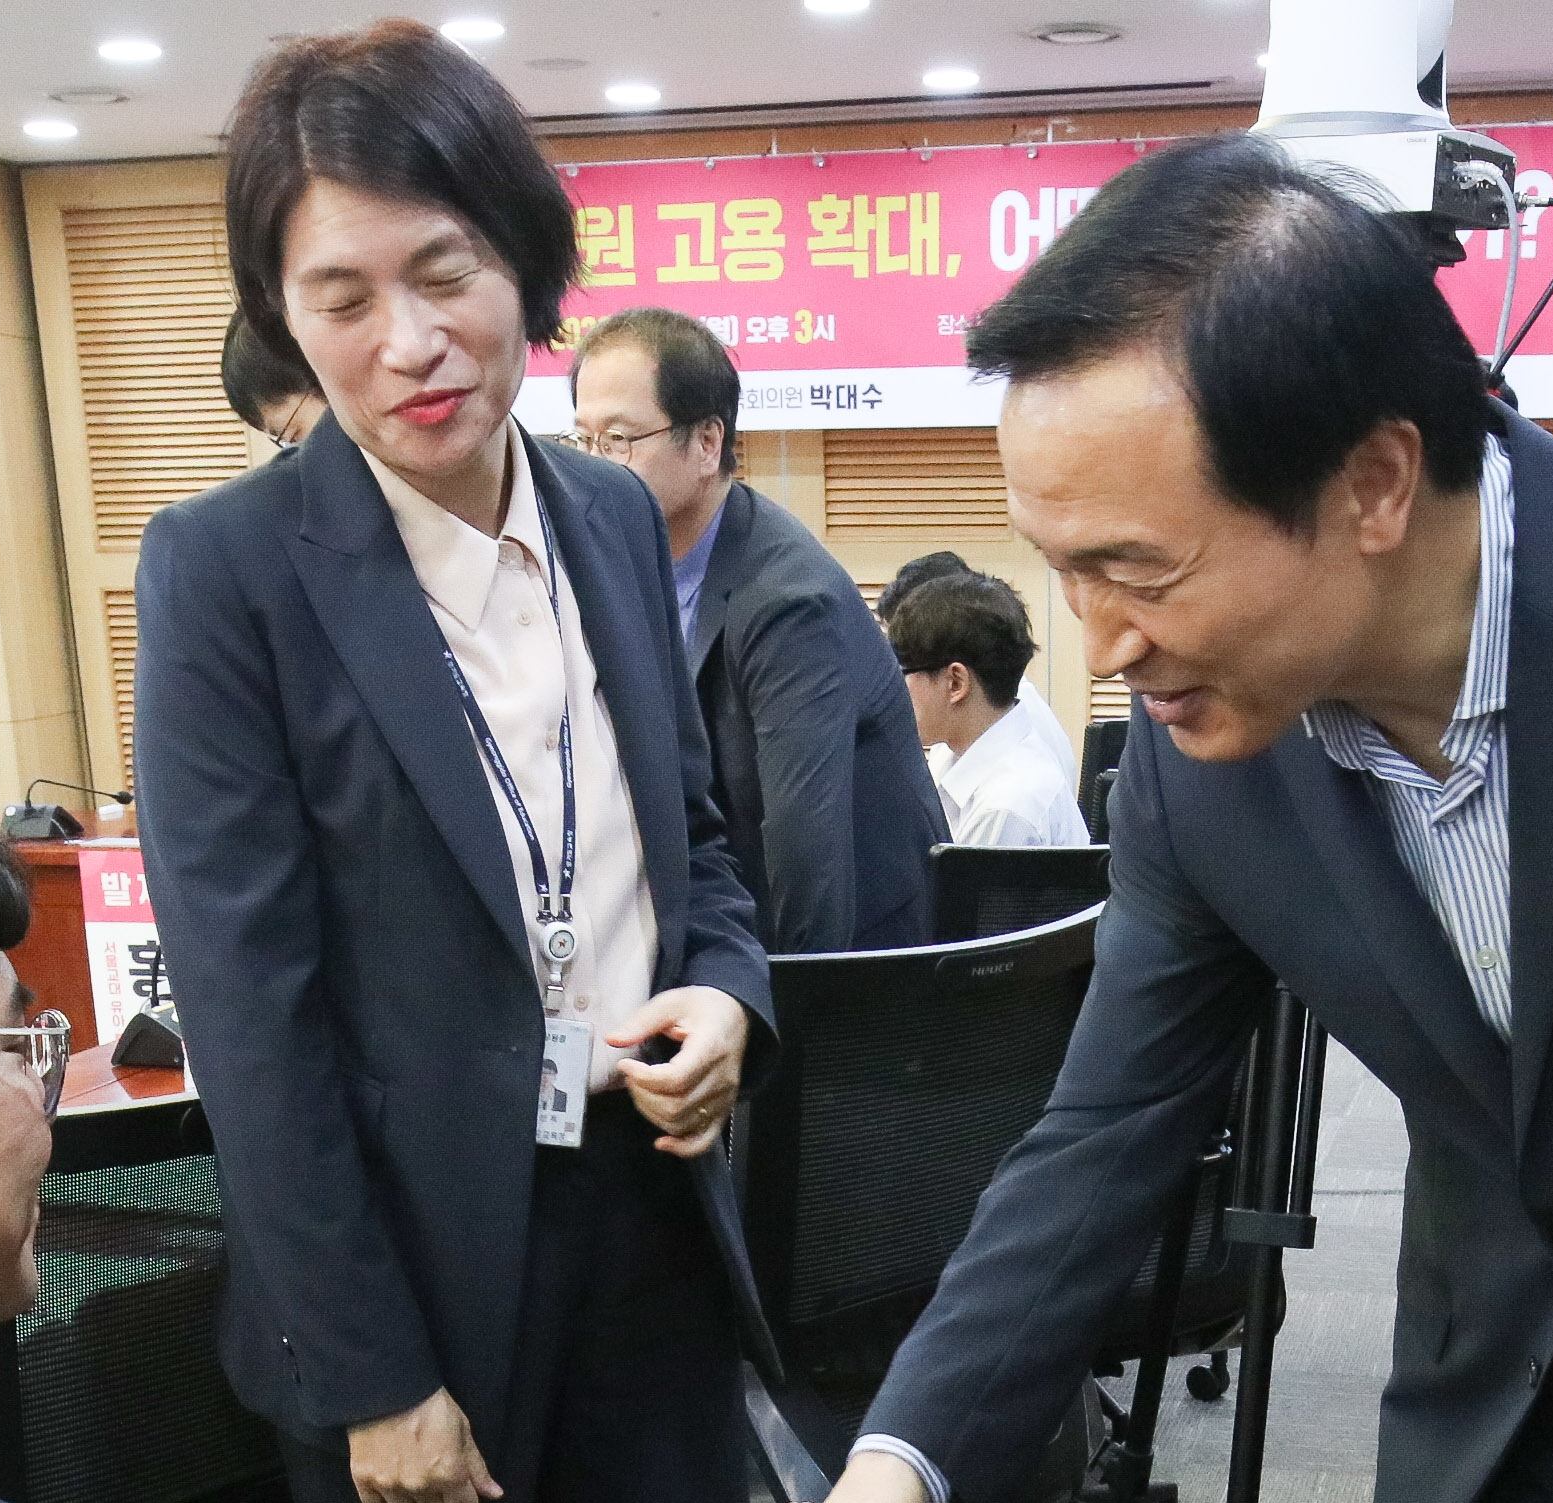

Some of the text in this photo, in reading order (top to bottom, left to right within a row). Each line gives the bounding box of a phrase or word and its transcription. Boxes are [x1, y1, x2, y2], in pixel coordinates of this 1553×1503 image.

[655, 198, 786, 284] 고용
[807, 192, 962, 279] 확대,
[746, 315, 789, 343] 오후
[794, 309, 835, 344] 3시
[810, 384, 883, 410] 박대수
[111, 1001, 126, 1042] 유아
